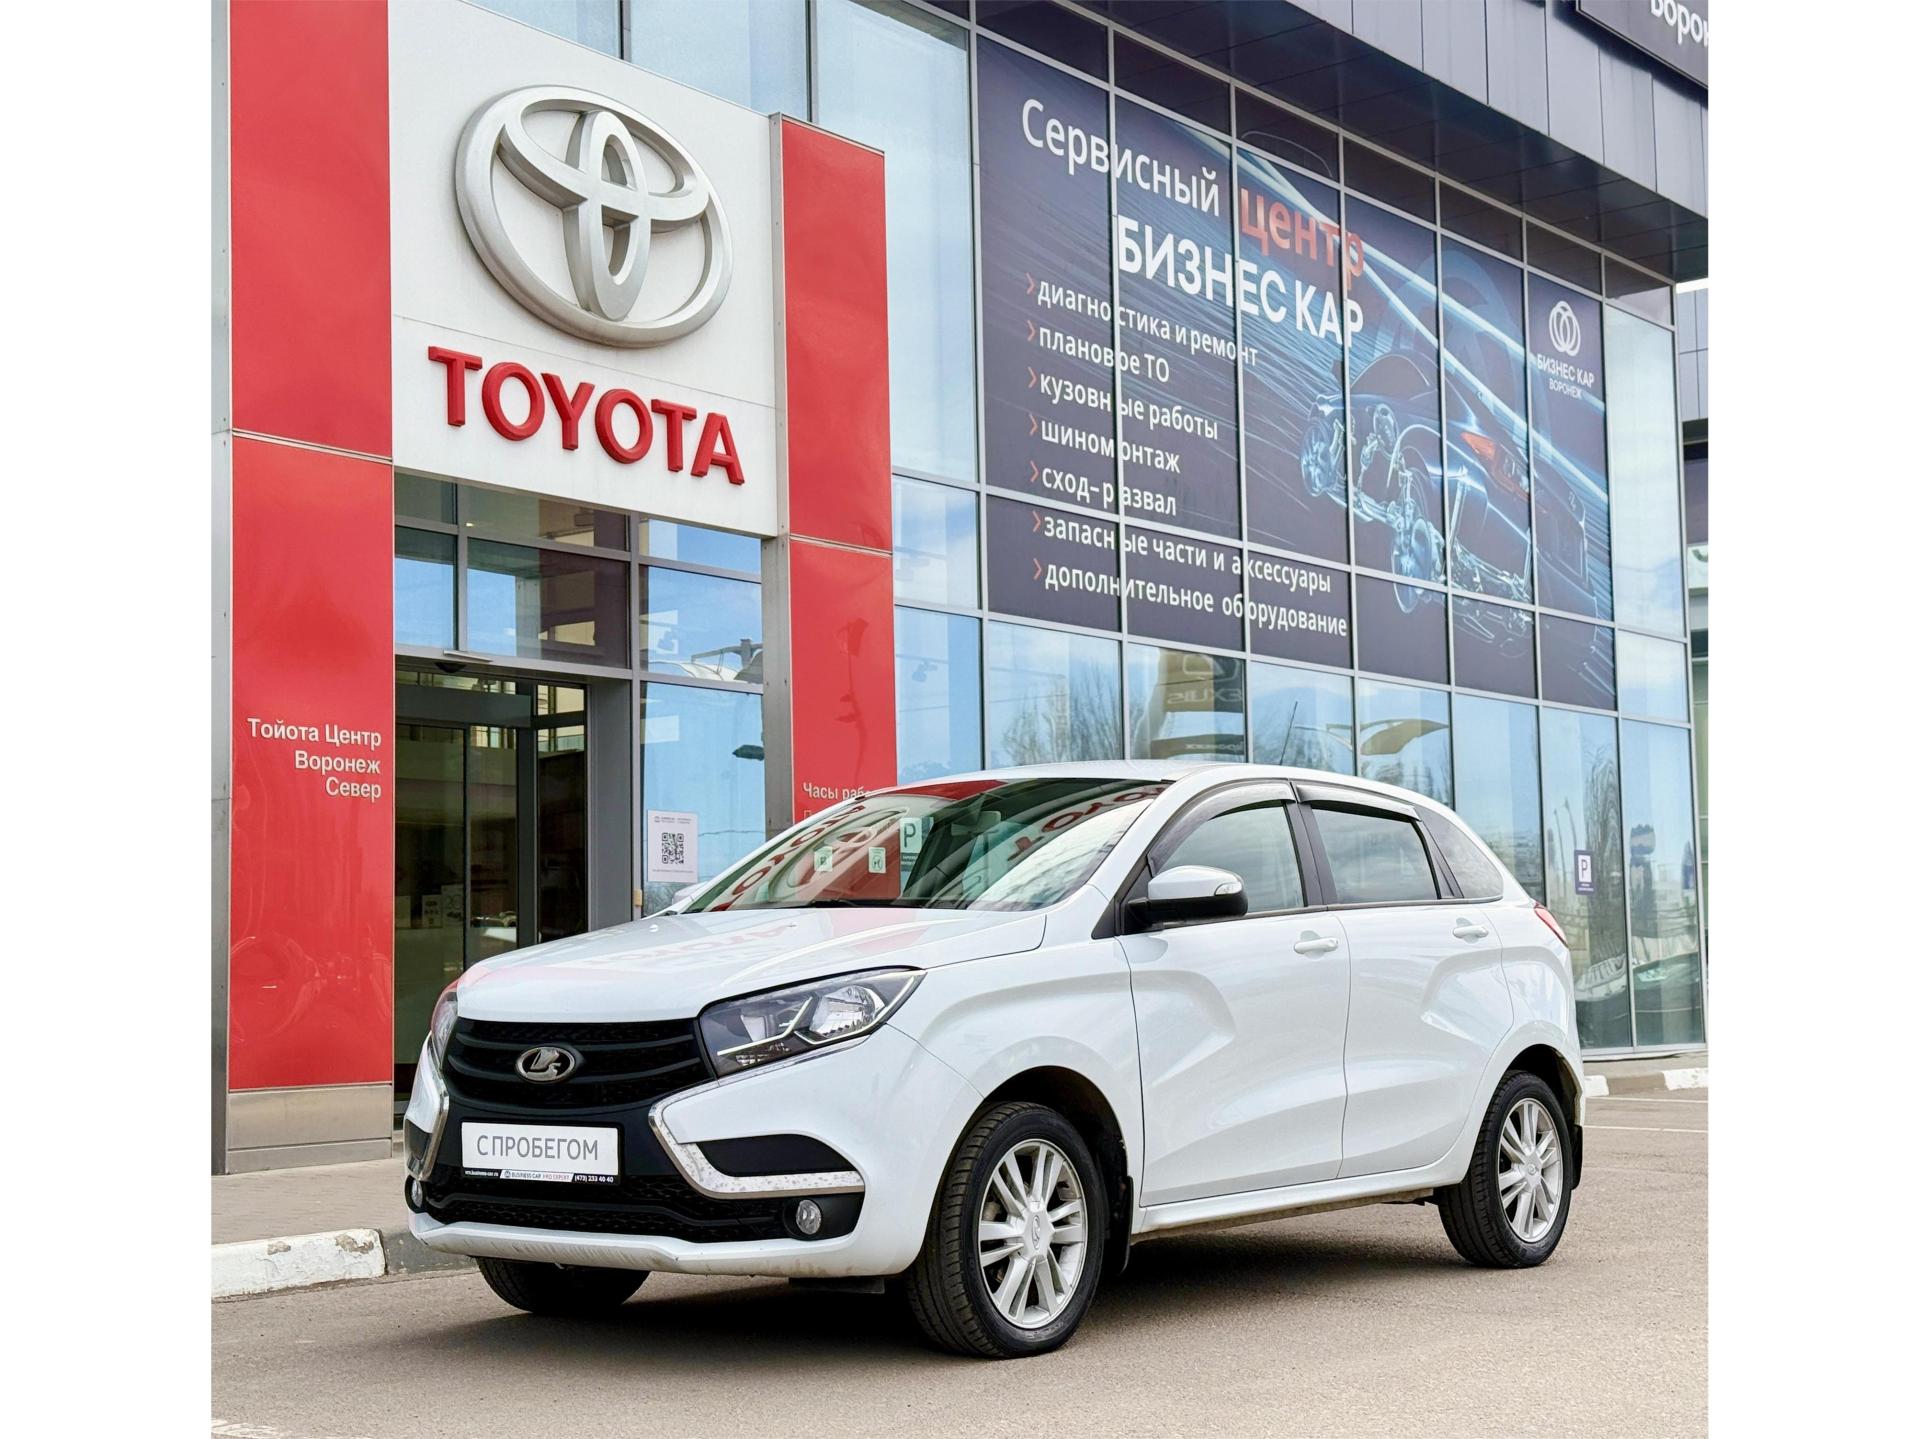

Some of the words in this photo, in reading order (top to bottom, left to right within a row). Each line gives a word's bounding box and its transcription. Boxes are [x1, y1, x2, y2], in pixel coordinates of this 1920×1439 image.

[1022, 98, 1220, 217] Сервисный
[1240, 188, 1365, 290] центр
[1118, 214, 1287, 323] БИЗНЕС
[1295, 279, 1364, 348] КАР
[1038, 280, 1170, 340] диагностика
[1175, 324, 1187, 345] и
[1191, 332, 1258, 367] ремонт
[1039, 327, 1140, 375] плановое
[1144, 353, 1170, 383] ТО
[1537, 354, 1575, 380] БИЗНЕС
[1577, 368, 1595, 388] КАР
[428, 346, 745, 485] TOYOTA
[1040, 373, 1144, 420] кузовные
[1150, 403, 1218, 440] работы
[1549, 378, 1582, 399] ВОРОНЕЖ
[1041, 420, 1181, 473] шиномонтаж
[1044, 515, 1148, 556] запасные
[1153, 539, 1206, 567] части
[1213, 551, 1225, 571] и
[1232, 555, 1331, 596] аксессуары
[1045, 564, 1214, 612] дополнительное
[1222, 593, 1347, 637] оборудование
[247, 717, 319, 742] Тойота
[325, 724, 382, 751] Центр
[295, 750, 381, 775] Воронеж
[325, 777, 382, 803] Север
[803, 782, 838, 800] Часы
[476, 1134, 489, 1156] С
[492, 1135, 599, 1161] ПРОБЕГОМ
